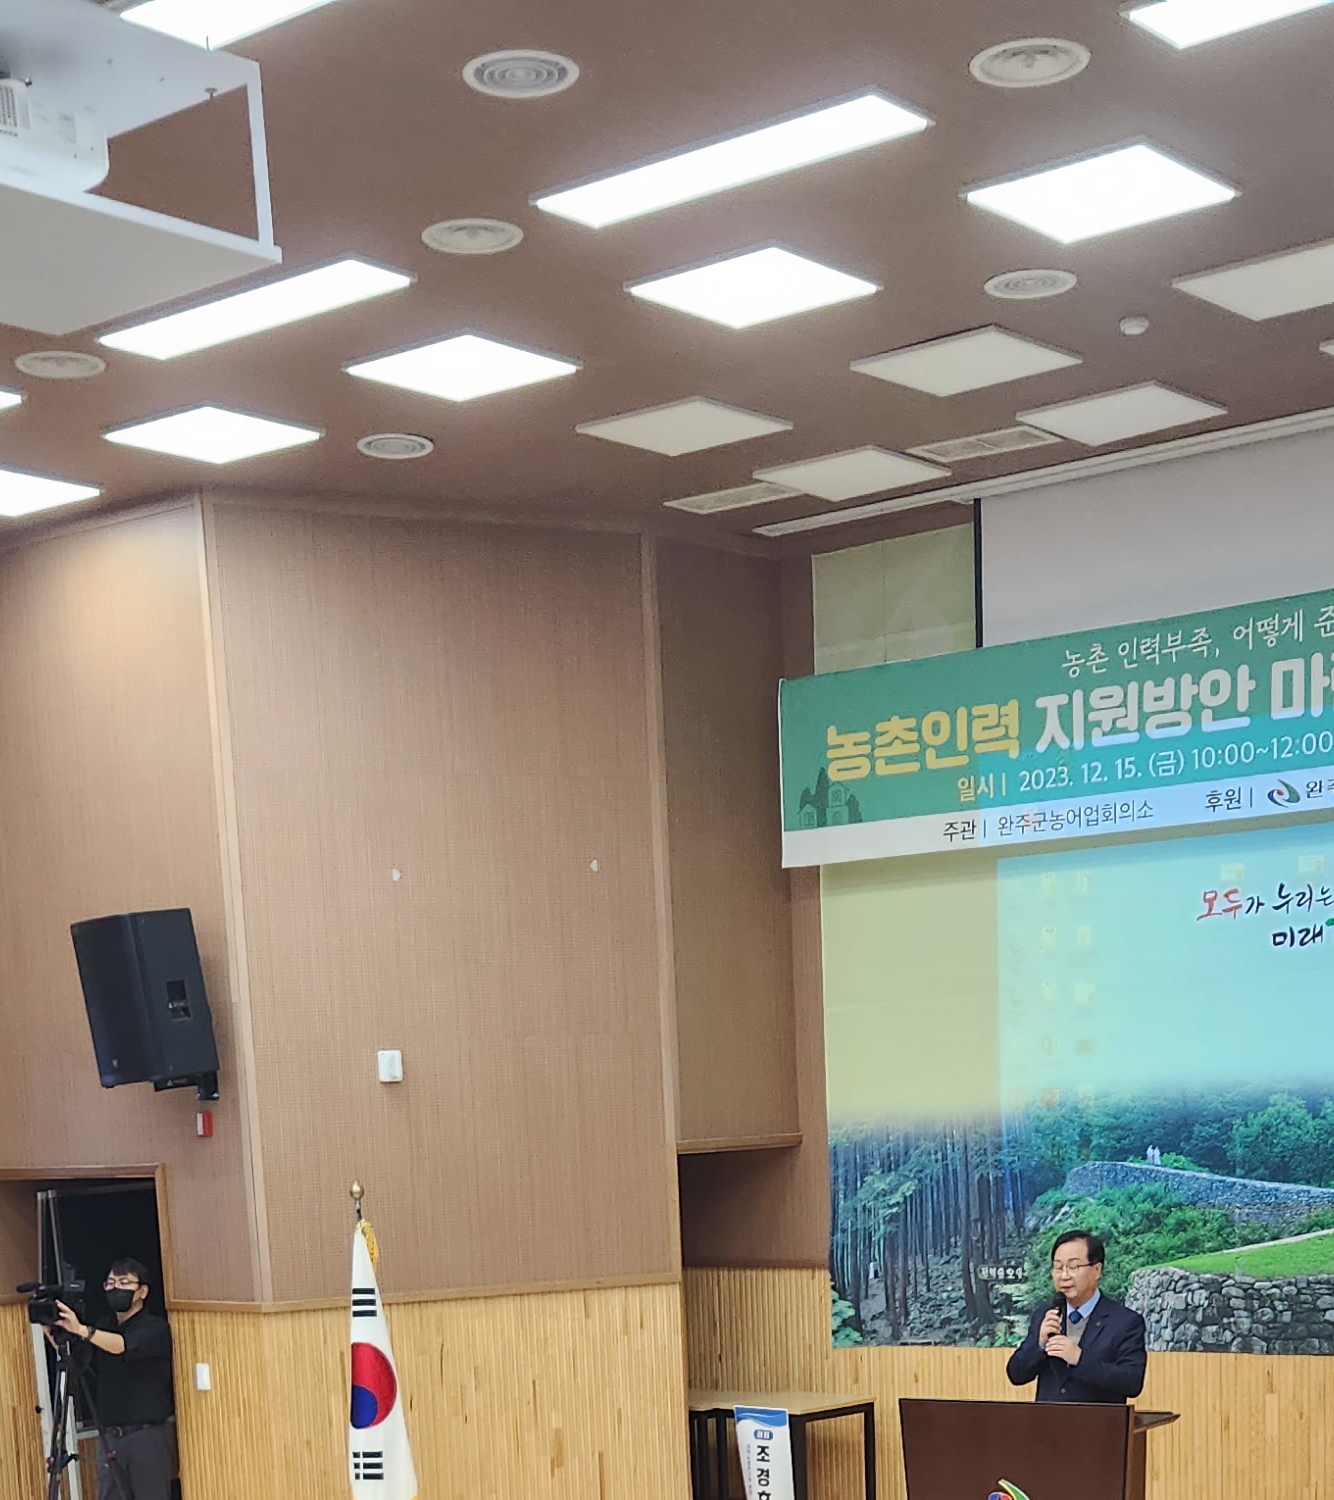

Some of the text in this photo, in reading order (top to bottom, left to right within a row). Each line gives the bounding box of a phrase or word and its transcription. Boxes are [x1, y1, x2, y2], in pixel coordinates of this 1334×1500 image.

[1061, 643, 1109, 679] 농촌
[1117, 627, 1220, 670] 인력부족,
[1233, 608, 1305, 651] 어떻게
[825, 699, 1021, 782] 농촌인력
[1035, 662, 1256, 754] 지원방안
[957, 730, 1334, 801] 일시 2023. 12. 15. (금) 10:00~12:00
[943, 800, 1155, 843] 주관 완주군농어업회의소
[1204, 787, 1243, 813] 후원
[1196, 886, 1266, 922] 모두가
[1271, 923, 1324, 948] 미래
